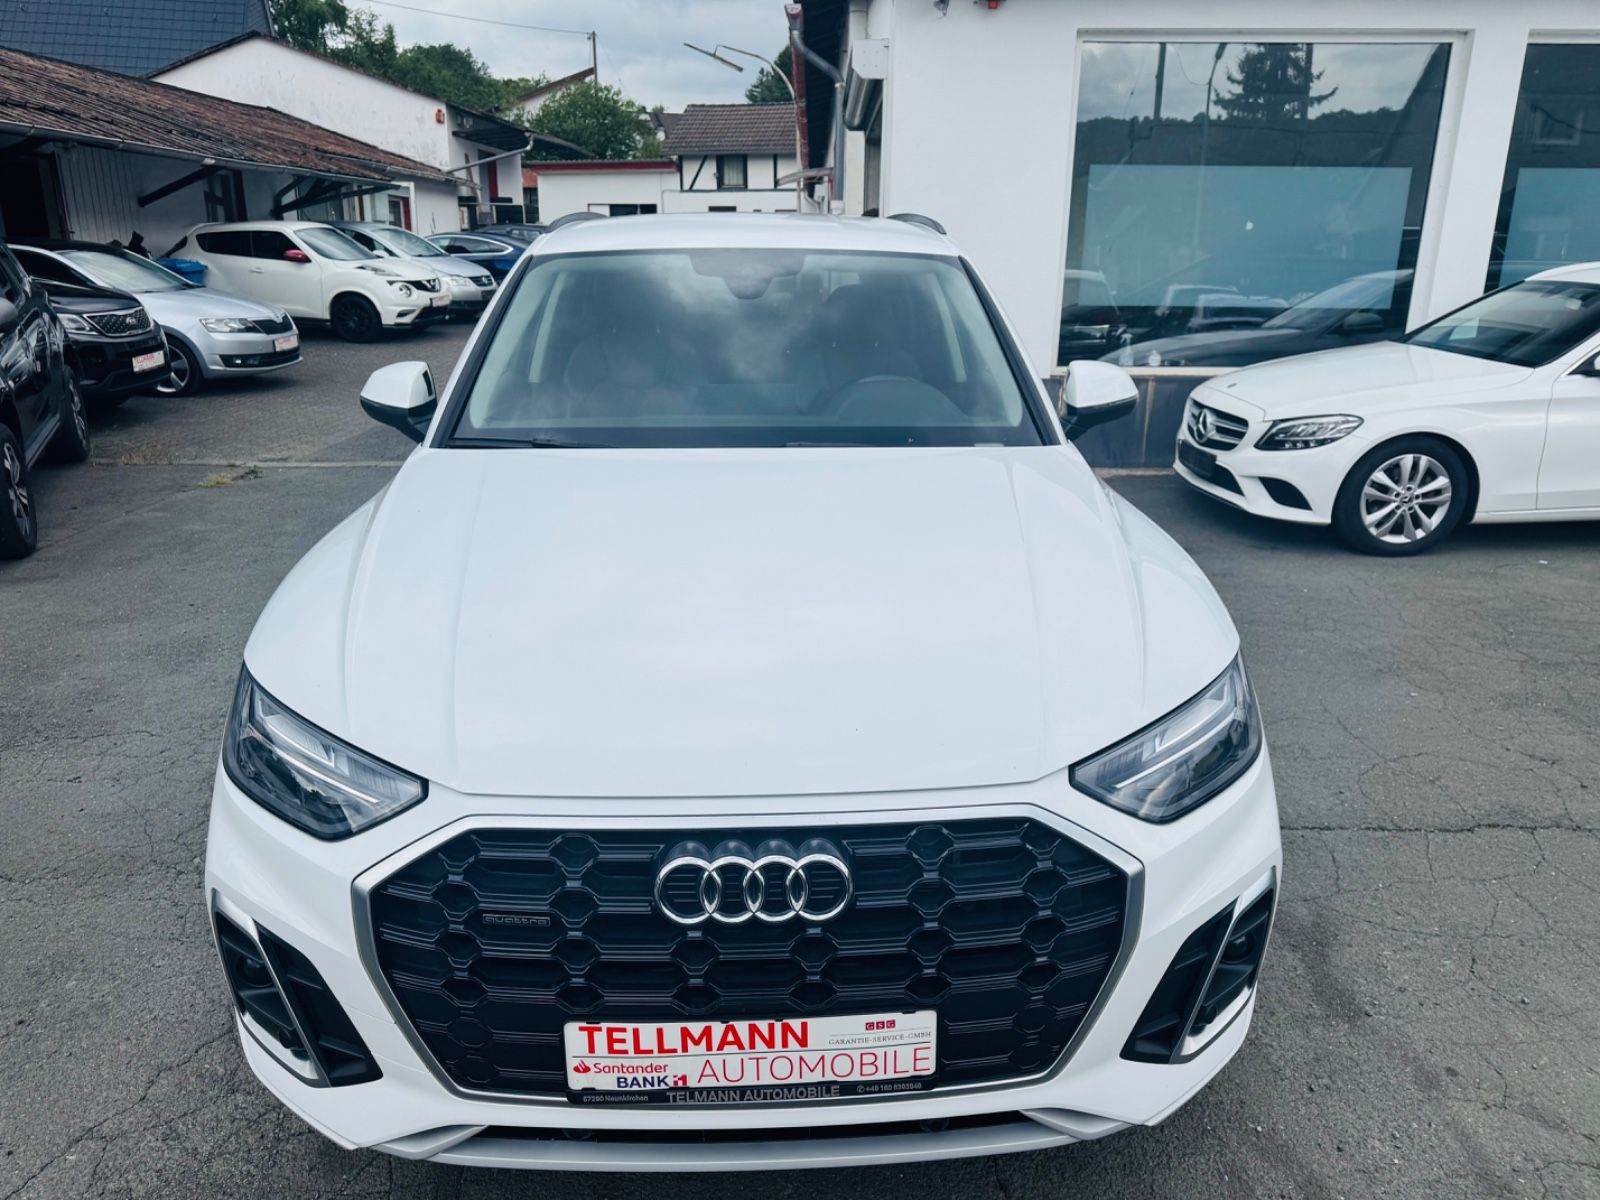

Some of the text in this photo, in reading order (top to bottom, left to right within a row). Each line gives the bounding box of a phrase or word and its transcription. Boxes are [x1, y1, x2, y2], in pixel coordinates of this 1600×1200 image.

[578, 1021, 809, 1055] TELLMANN
[593, 1062, 669, 1074] Santander
[697, 1046, 931, 1084] AUTOMOBILE
[616, 1075, 670, 1089] BANK
[666, 1085, 840, 1104] TELMANN AUTOMOBILE
